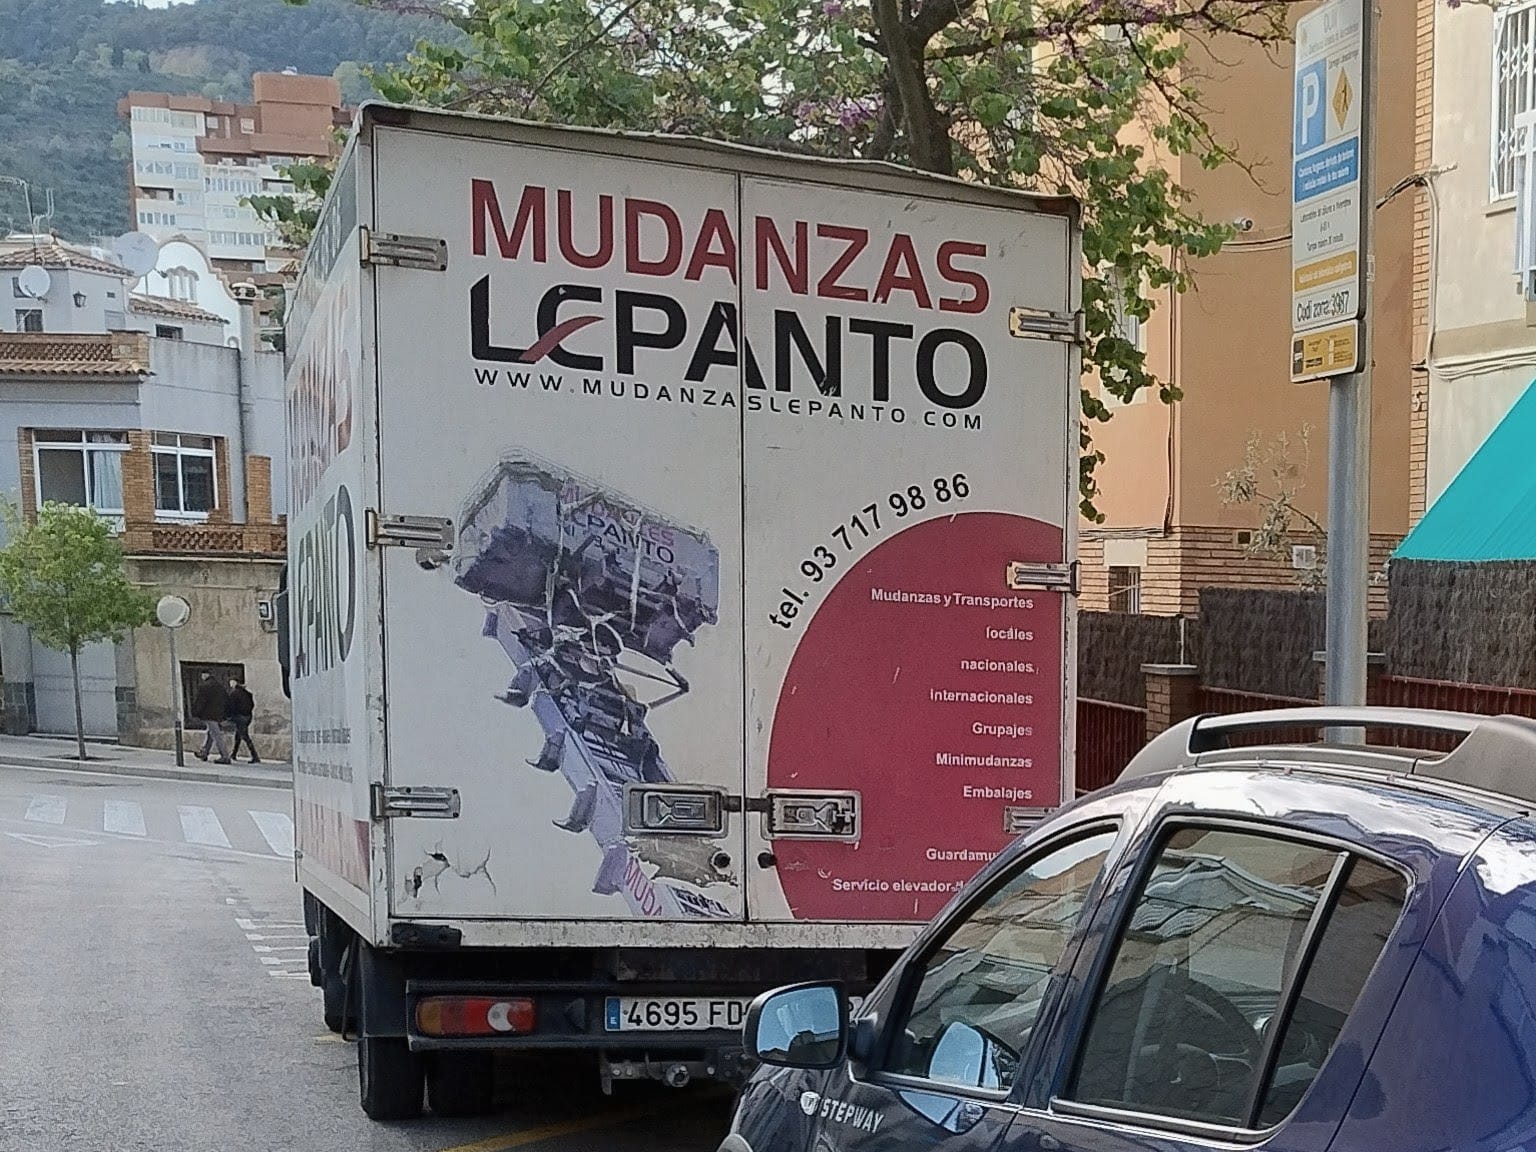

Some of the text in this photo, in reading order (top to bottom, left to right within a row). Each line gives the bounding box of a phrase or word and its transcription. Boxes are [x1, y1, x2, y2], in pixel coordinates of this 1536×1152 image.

[471, 178, 990, 314] MUDANZAS
[470, 273, 988, 410] LEPANTO
[769, 473, 970, 629] tel. 93 717 98 86
[871, 587, 1034, 610] Mudanzas y Transportes
[986, 626, 1034, 641] locales
[930, 688, 1034, 705] Internacionales
[972, 722, 1033, 739] Grupajes
[936, 753, 1033, 769] Minimudanzas
[963, 785, 1033, 801] Embalajes
[832, 878, 890, 892] Servicio
[892, 880, 951, 892] elevador
[627, 1001, 752, 1026] 4695 FD
[820, 1098, 885, 1134] STEPWAY
